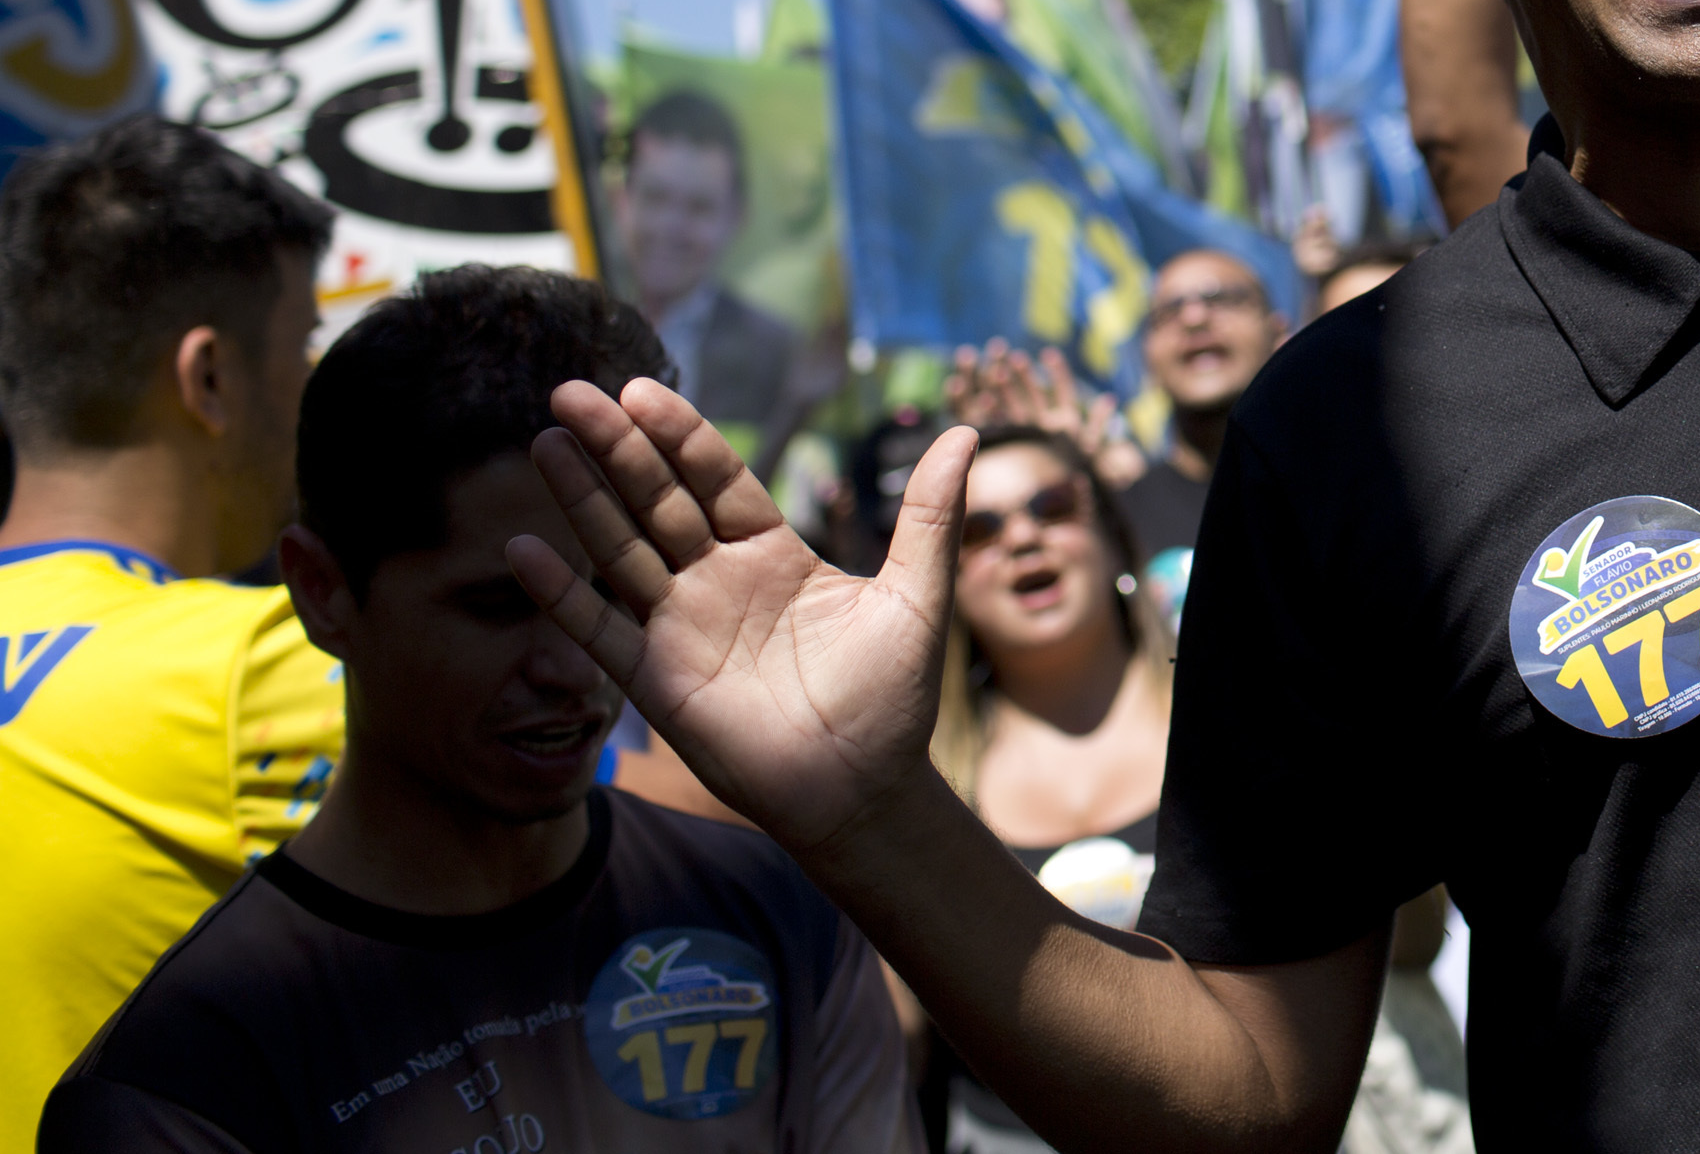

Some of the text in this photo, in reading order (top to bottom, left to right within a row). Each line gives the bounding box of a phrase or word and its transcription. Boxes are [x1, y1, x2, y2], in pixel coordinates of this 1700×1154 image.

[1553, 552, 1693, 636] BOLSONARO
[1583, 546, 1632, 578] SENADOR
[1593, 560, 1633, 587] FLÁVIO
[1591, 620, 1612, 637] PAULO
[1640, 589, 1674, 610] LEONARDO
[329, 1089, 372, 1124] Em
[525, 1001, 571, 1037] pela
[617, 1018, 767, 1103] 177
